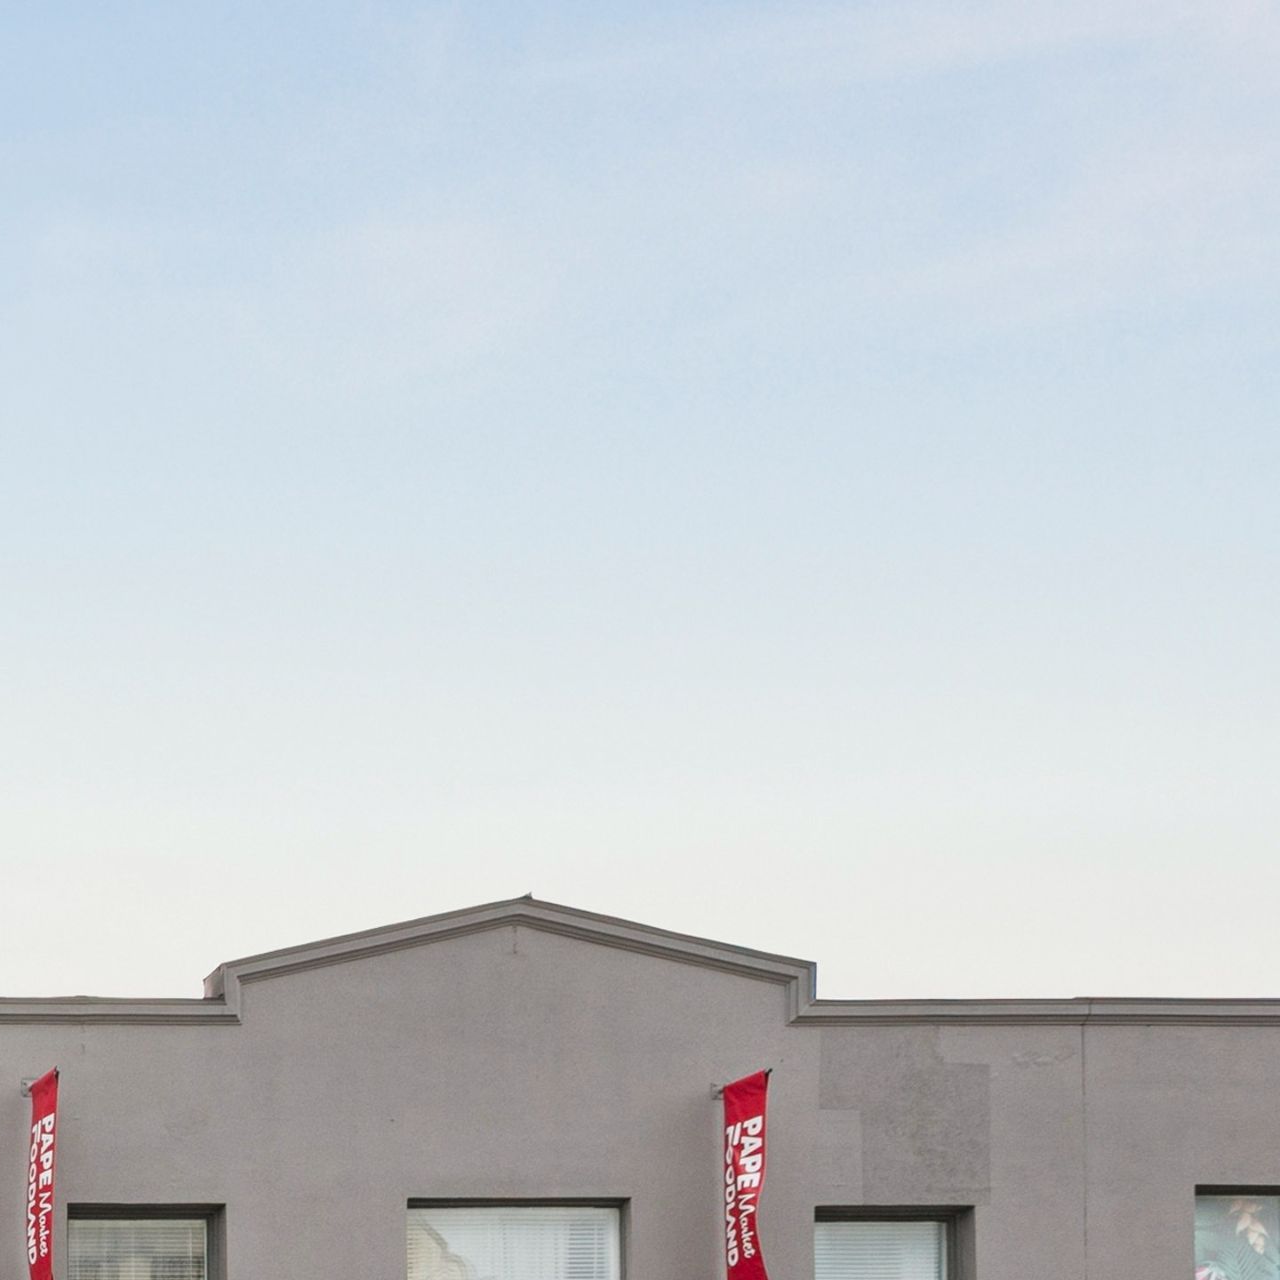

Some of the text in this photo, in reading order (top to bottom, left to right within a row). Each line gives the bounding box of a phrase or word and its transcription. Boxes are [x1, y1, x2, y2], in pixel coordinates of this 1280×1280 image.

[27, 1119, 41, 1265] FOODLAND
[38, 1112, 56, 1257] PAPE Market
[726, 1121, 742, 1267] FOODLAND
[737, 1115, 763, 1258] PAPE Market
